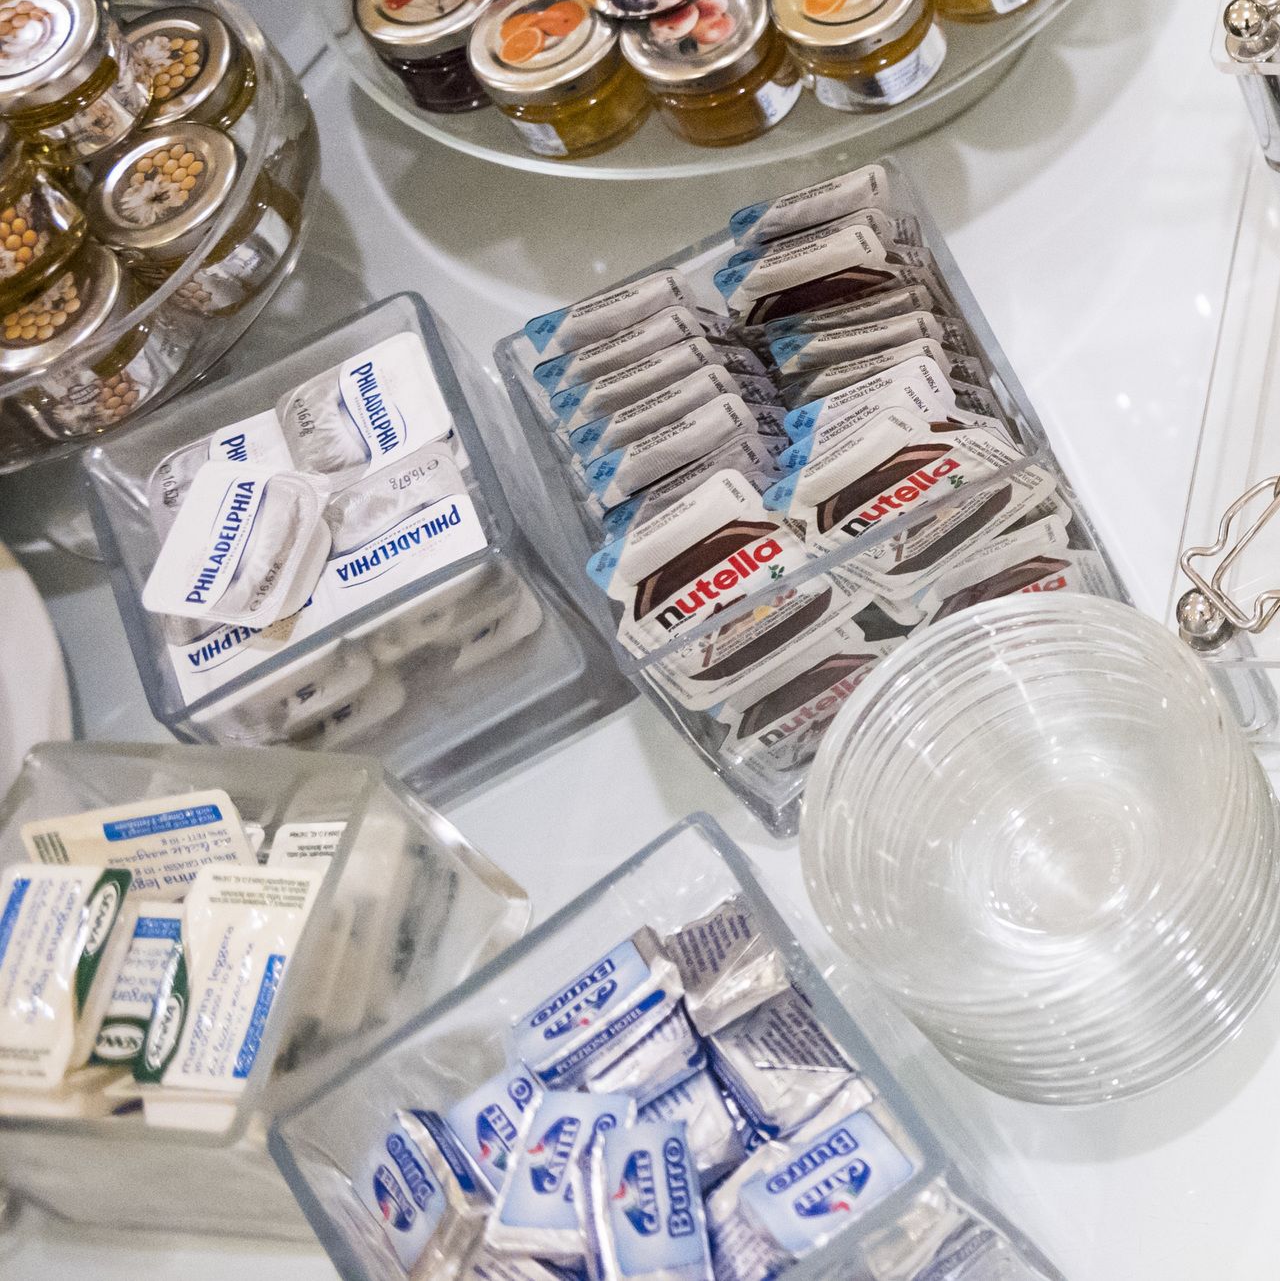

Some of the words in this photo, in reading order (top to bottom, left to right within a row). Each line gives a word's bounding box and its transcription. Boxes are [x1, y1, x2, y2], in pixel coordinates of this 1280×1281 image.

[349, 361, 401, 455] PHILADELPHIA
[840, 457, 961, 538] nutella
[185, 480, 256, 605] PHILADELPHIA
[335, 504, 462, 583] PHILADELPHIA
[654, 537, 783, 631] nutella
[530, 957, 616, 1028] Burro
[544, 1116, 581, 1194] CATTEL
[630, 1151, 661, 1237] CATTEL
[663, 1136, 696, 1239] Burro
[767, 1128, 858, 1196] Burro
